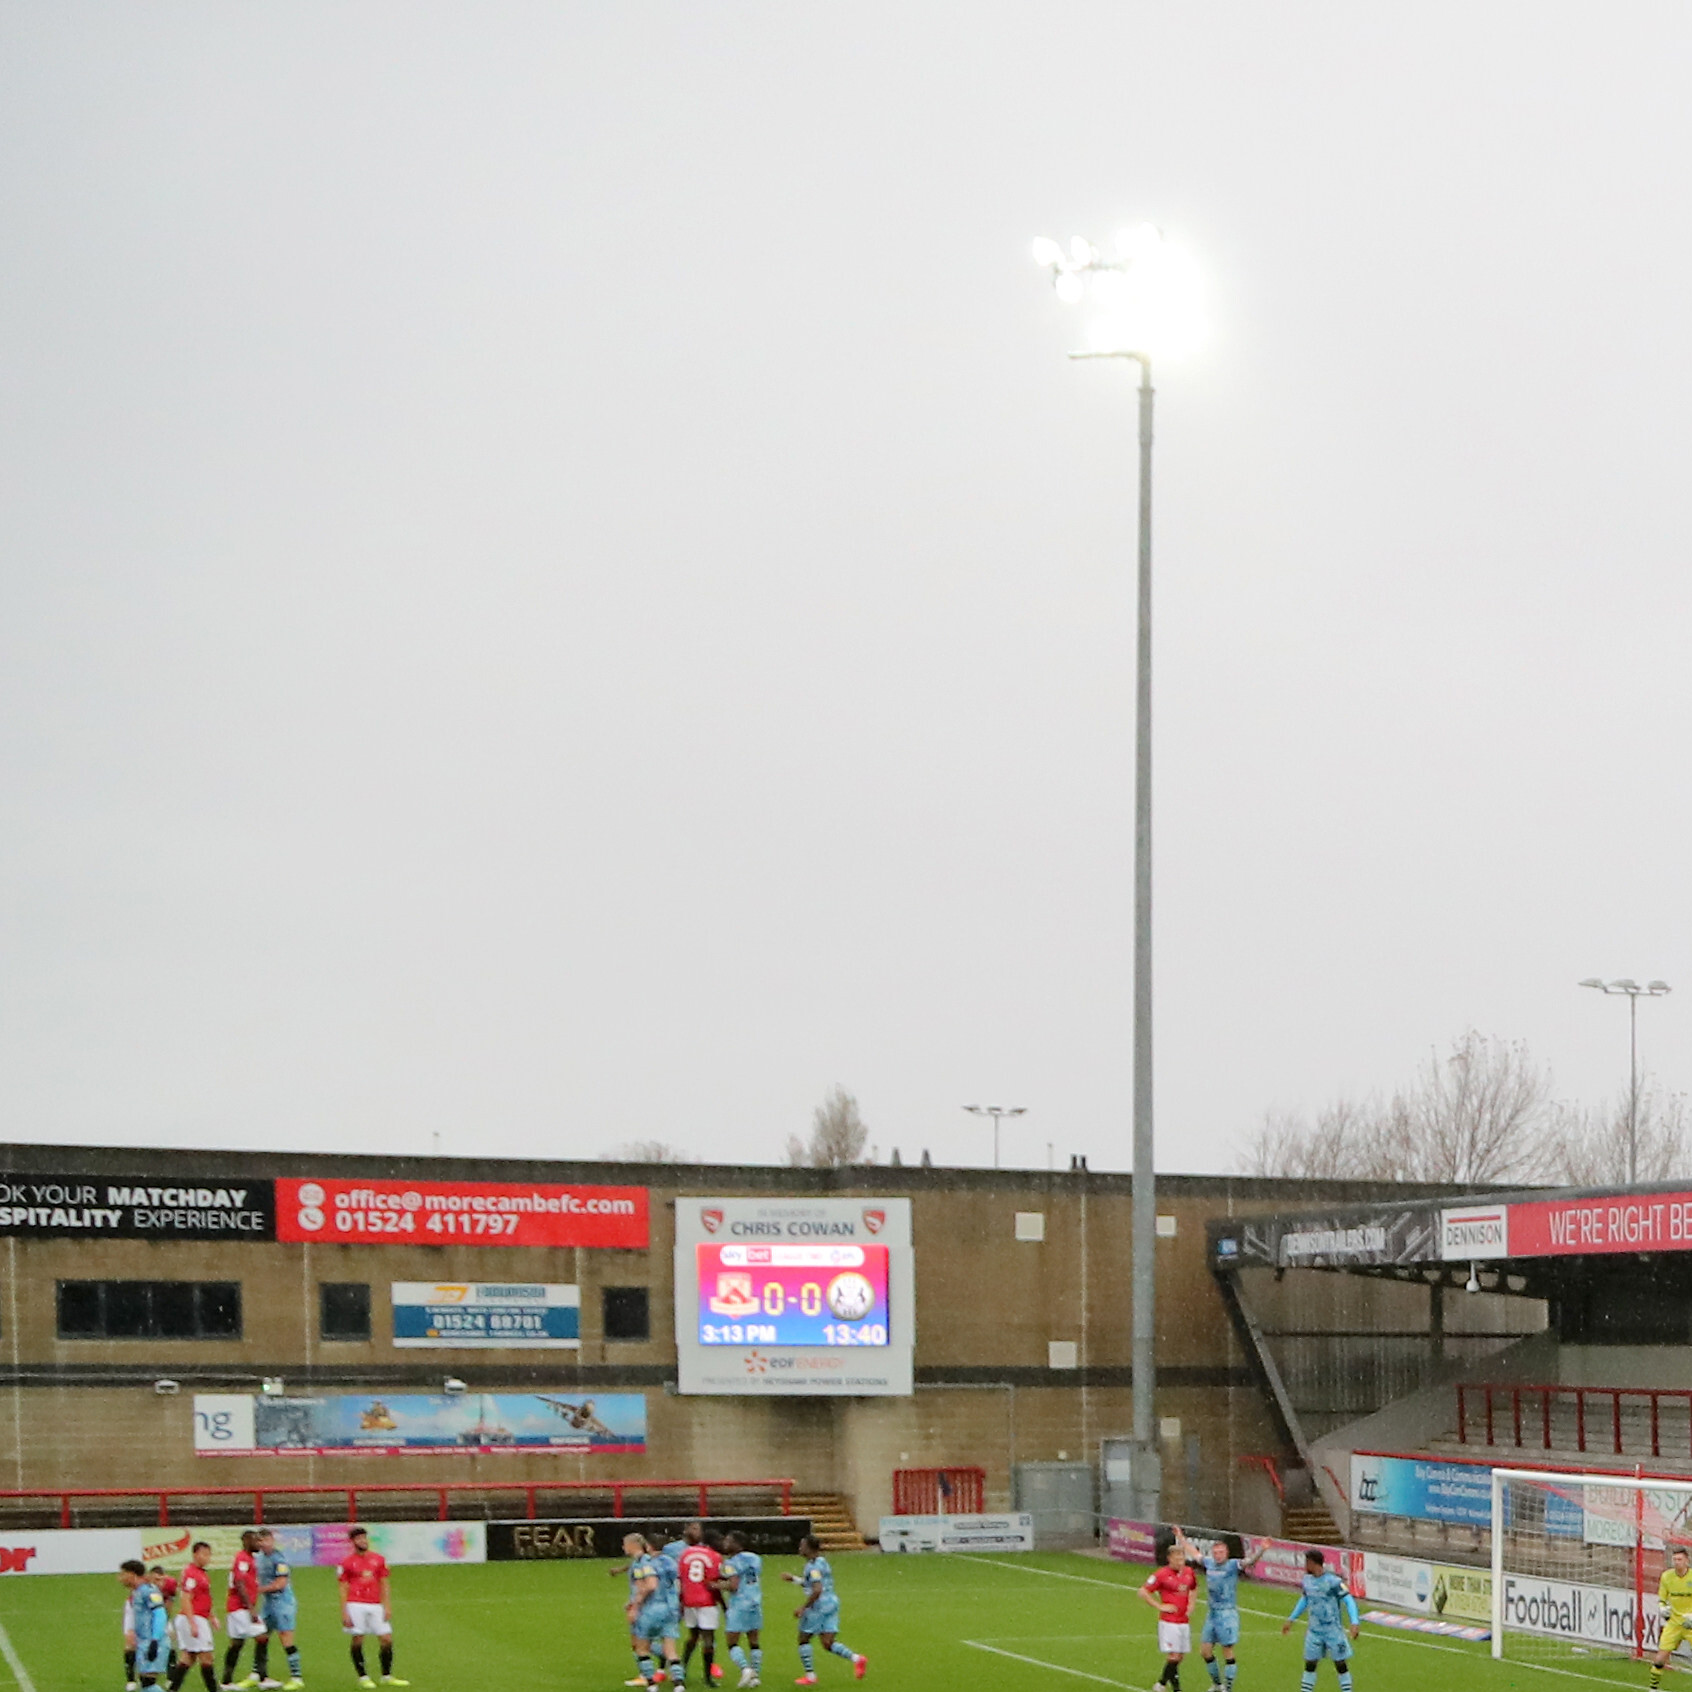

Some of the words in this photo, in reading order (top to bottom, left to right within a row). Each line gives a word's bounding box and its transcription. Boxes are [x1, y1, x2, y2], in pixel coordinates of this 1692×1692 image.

[32, 1185, 97, 1205] YOUR
[107, 1186, 248, 1208] MATCHDAY
[335, 1188, 635, 1215] office@morecambefc.com
[134, 1210, 264, 1231] EXPERIENCE
[335, 1211, 416, 1233] 01524
[425, 1212, 519, 1235] 411797
[731, 1221, 782, 1236] CHRIS
[787, 1221, 854, 1236] COWAN
[1549, 1211, 1602, 1246] WE'RE
[1608, 1206, 1666, 1242] RIGHT
[1446, 1222, 1502, 1247] DENNISON
[703, 1325, 744, 1342] 3:13
[747, 1325, 777, 1342] PM
[823, 1325, 887, 1344] 13:40
[514, 1526, 595, 1549] FEAR
[688, 1559, 705, 1583] 8
[1504, 1580, 1582, 1634] Football
[1604, 1594, 1663, 1645] Indx
